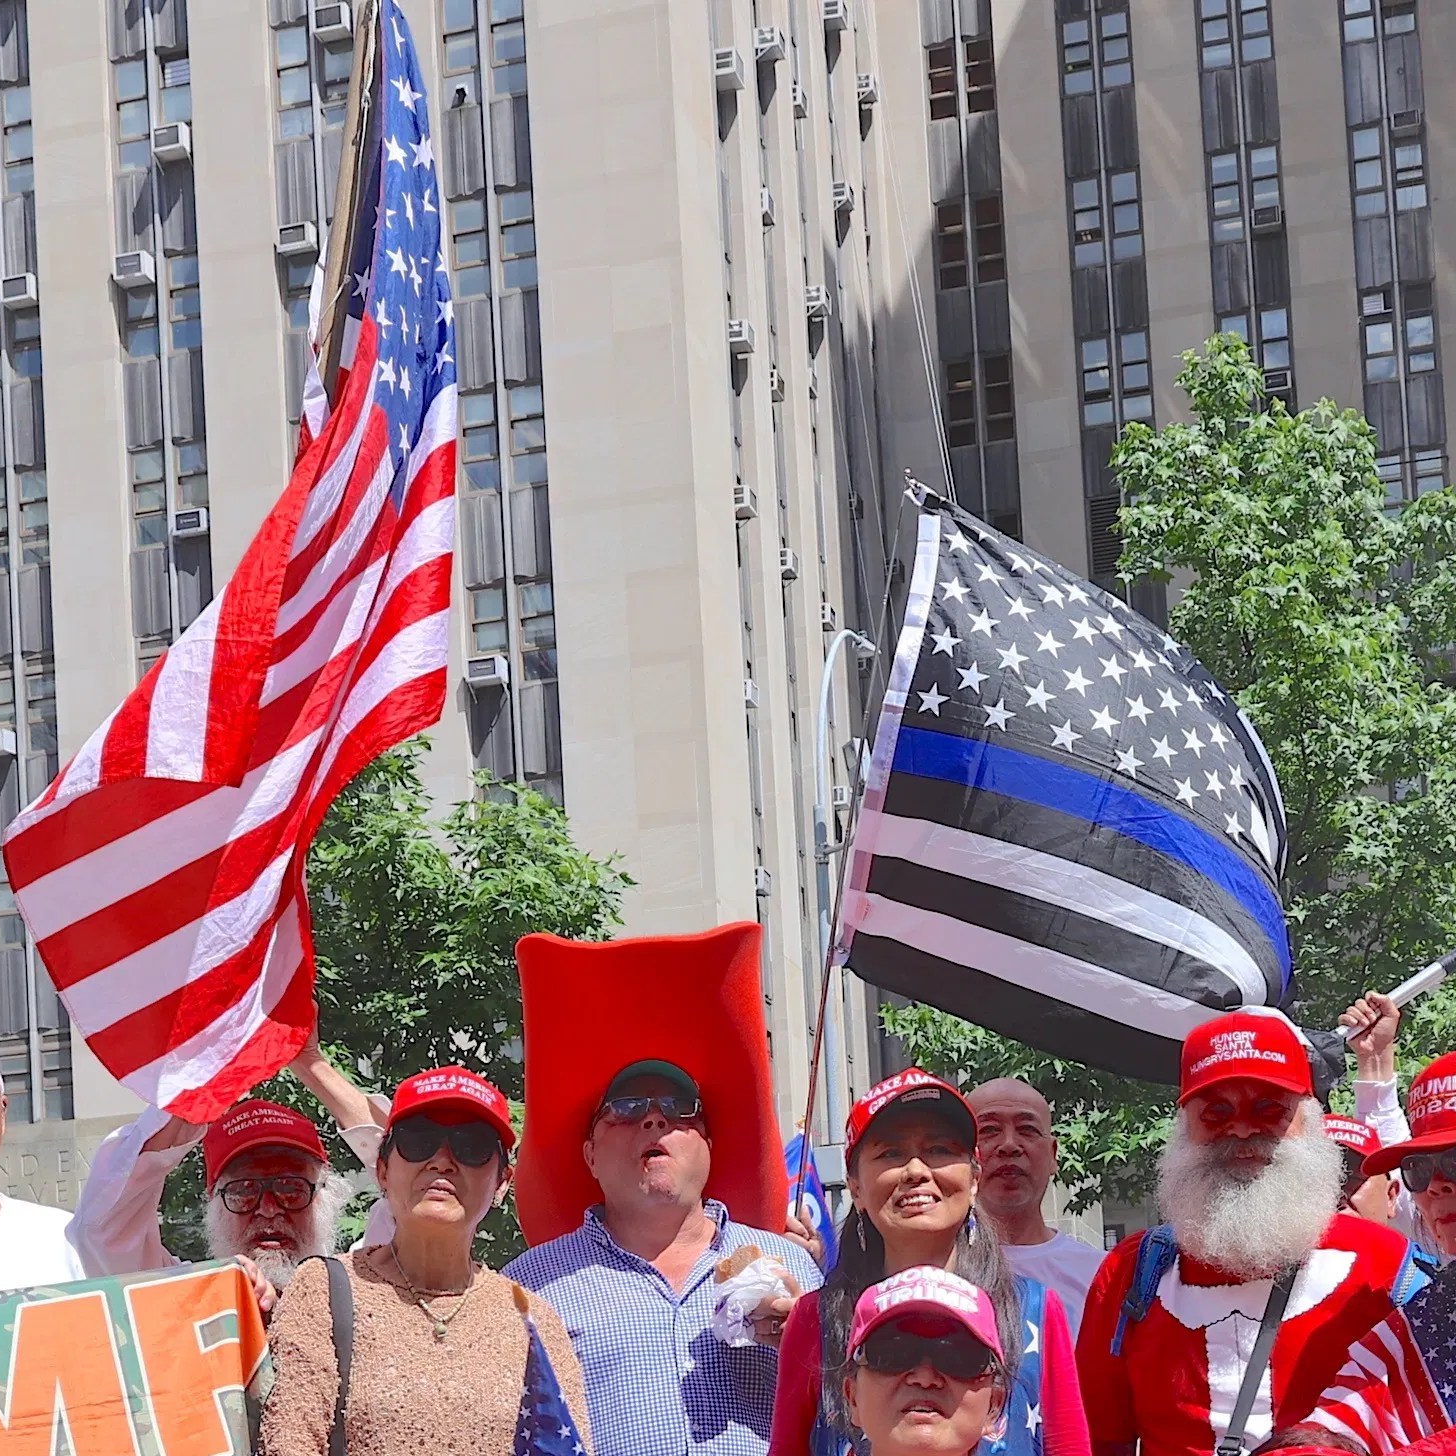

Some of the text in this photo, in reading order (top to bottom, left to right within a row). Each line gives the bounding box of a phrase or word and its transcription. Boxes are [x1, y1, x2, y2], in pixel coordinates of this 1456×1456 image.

[1209, 1031, 1257, 1047] HUNGRY
[1214, 1040, 1253, 1054] SANTA
[1189, 1049, 1287, 1075] HUNGRYSANTA.COM
[412, 1074, 497, 1103] MAKE AMERICA
[416, 1082, 493, 1107] GREAT AGAIN
[223, 1110, 250, 1130] MAKE
[227, 1116, 295, 1136] GREAT AGAIN
[1326, 1119, 1372, 1139] MERICA
[1327, 1131, 1365, 1147] AGAIN
[876, 1265, 978, 1299] WOMEN
[874, 1287, 979, 1313] TRUMP
